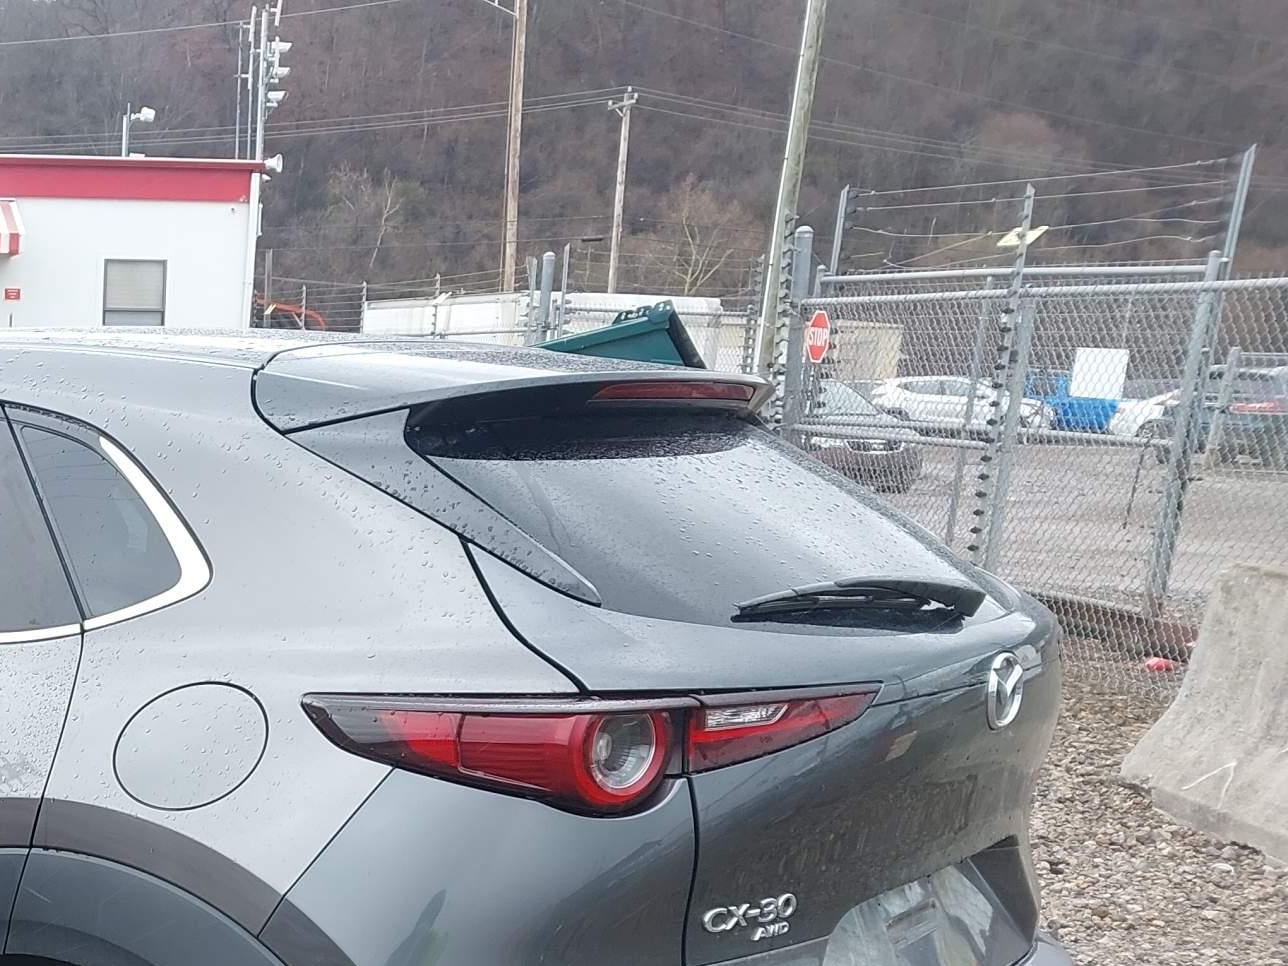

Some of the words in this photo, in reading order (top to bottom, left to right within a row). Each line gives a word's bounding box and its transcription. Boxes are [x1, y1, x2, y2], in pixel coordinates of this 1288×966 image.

[807, 326, 829, 347] STOP
[703, 893, 798, 933] CX-30
[752, 921, 790, 941] AWD
